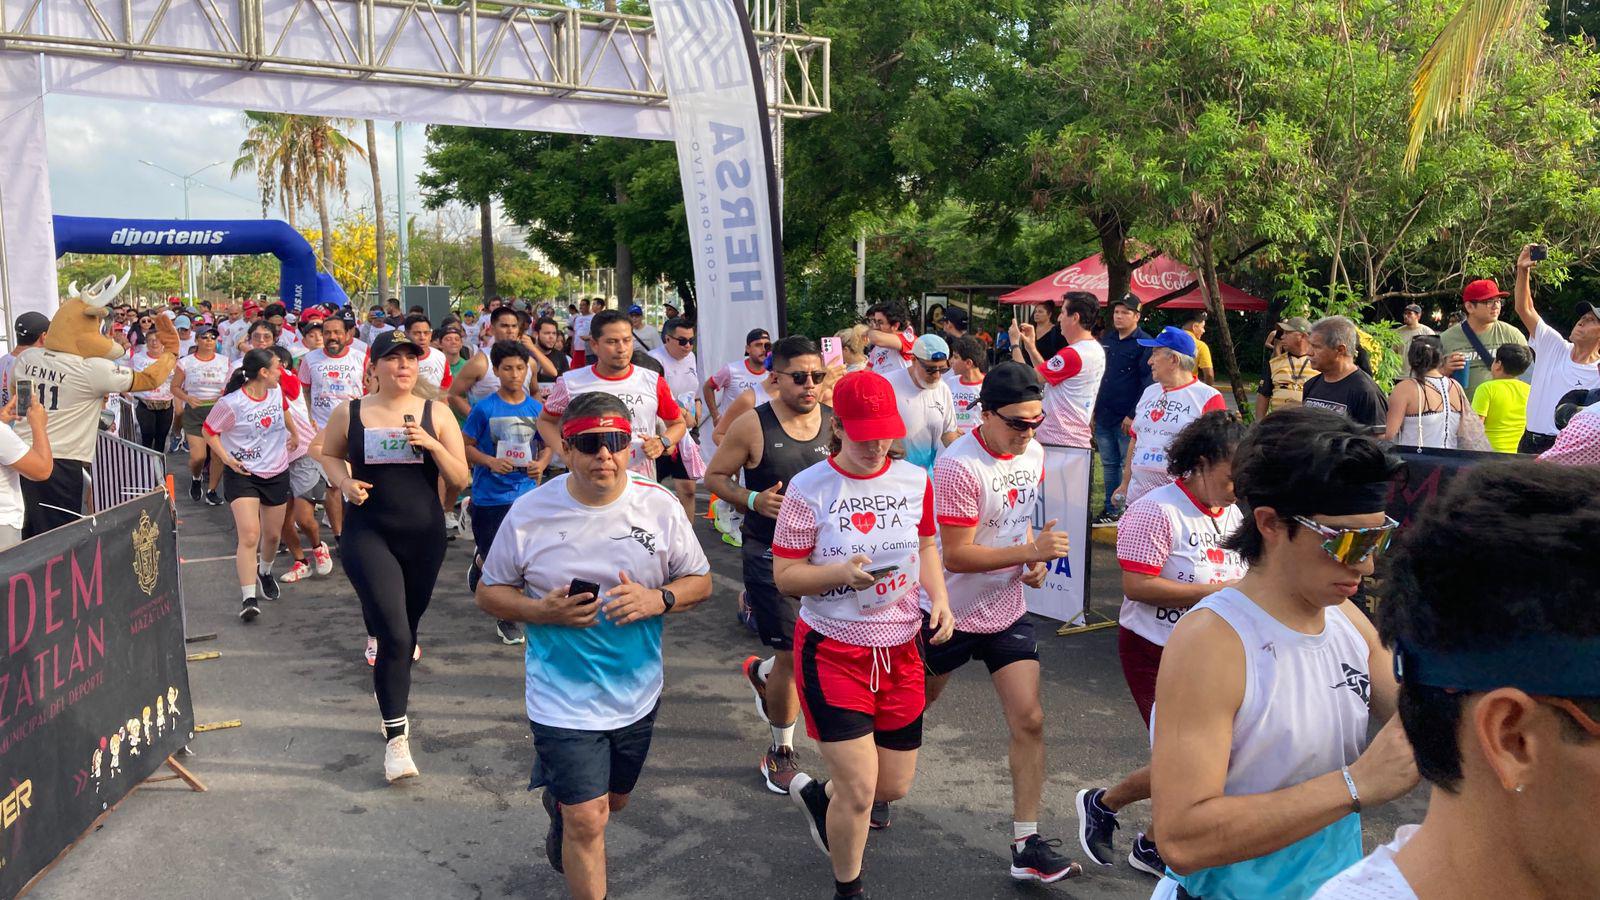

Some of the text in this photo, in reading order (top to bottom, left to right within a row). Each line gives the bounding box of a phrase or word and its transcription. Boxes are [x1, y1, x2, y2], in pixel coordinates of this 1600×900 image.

[1144, 399, 1190, 414] CARRERA
[380, 440, 407, 450] 127
[992, 470, 1038, 492] CARRERA
[828, 495, 909, 514] CARRERA
[822, 546, 847, 557] 2.5K,
[851, 544, 866, 554] 5K
[875, 574, 907, 595] 012
